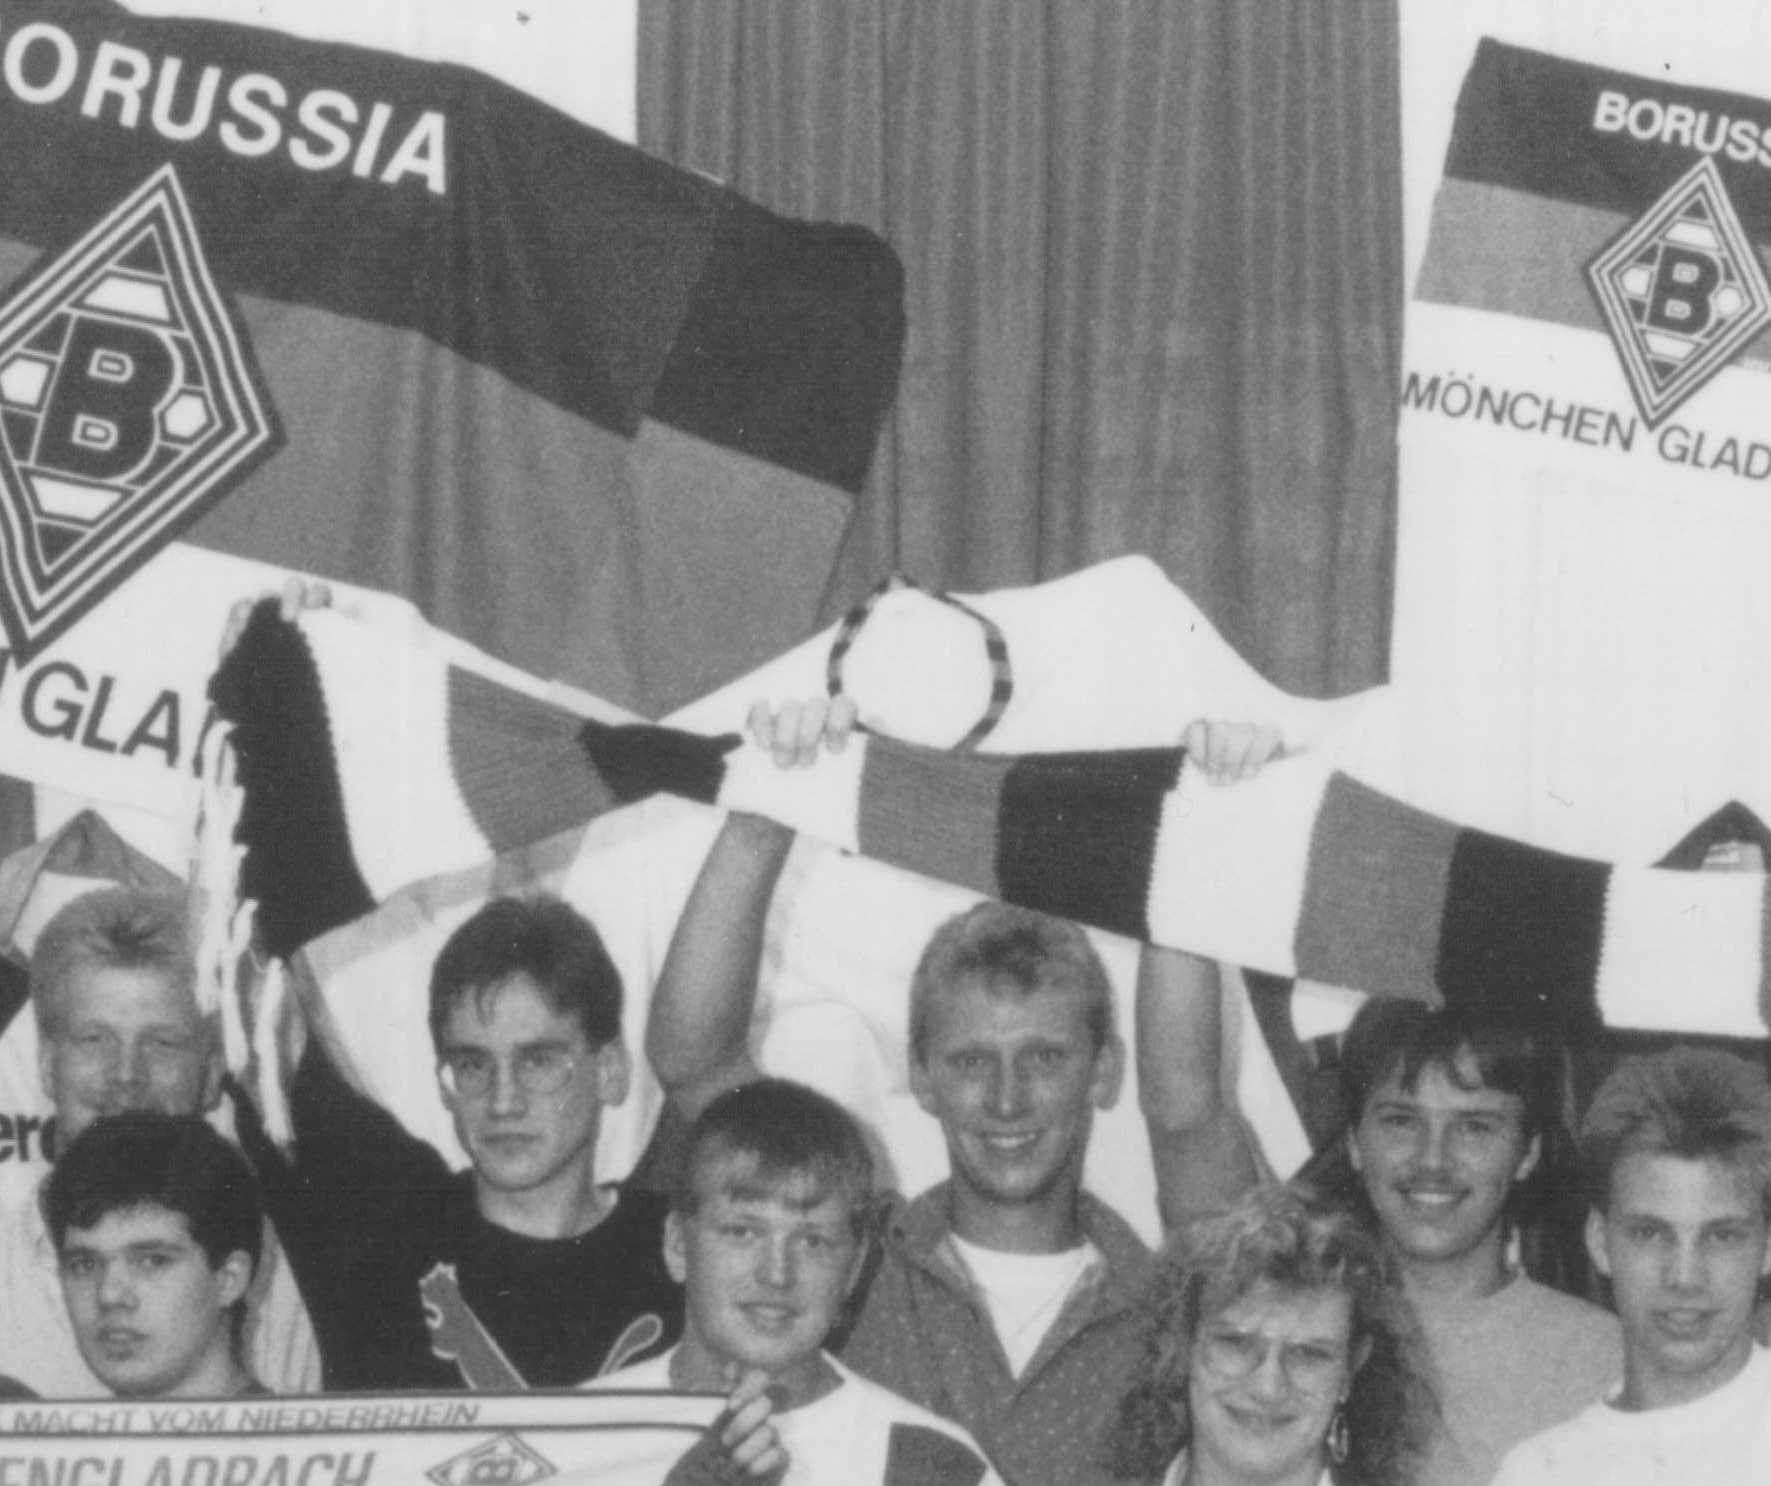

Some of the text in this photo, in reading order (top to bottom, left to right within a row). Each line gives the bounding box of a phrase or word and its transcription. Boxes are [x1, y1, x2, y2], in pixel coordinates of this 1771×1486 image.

[1646, 242, 1721, 337] B
[29, 310, 185, 486] B
[1402, 368, 1637, 453] MÖNCHEN
[23, 660, 211, 779] GLA
[13, 1406, 140, 1433] MACHT
[149, 1406, 229, 1433] VOM
[237, 1403, 480, 1432] NIEDERRHEIN
